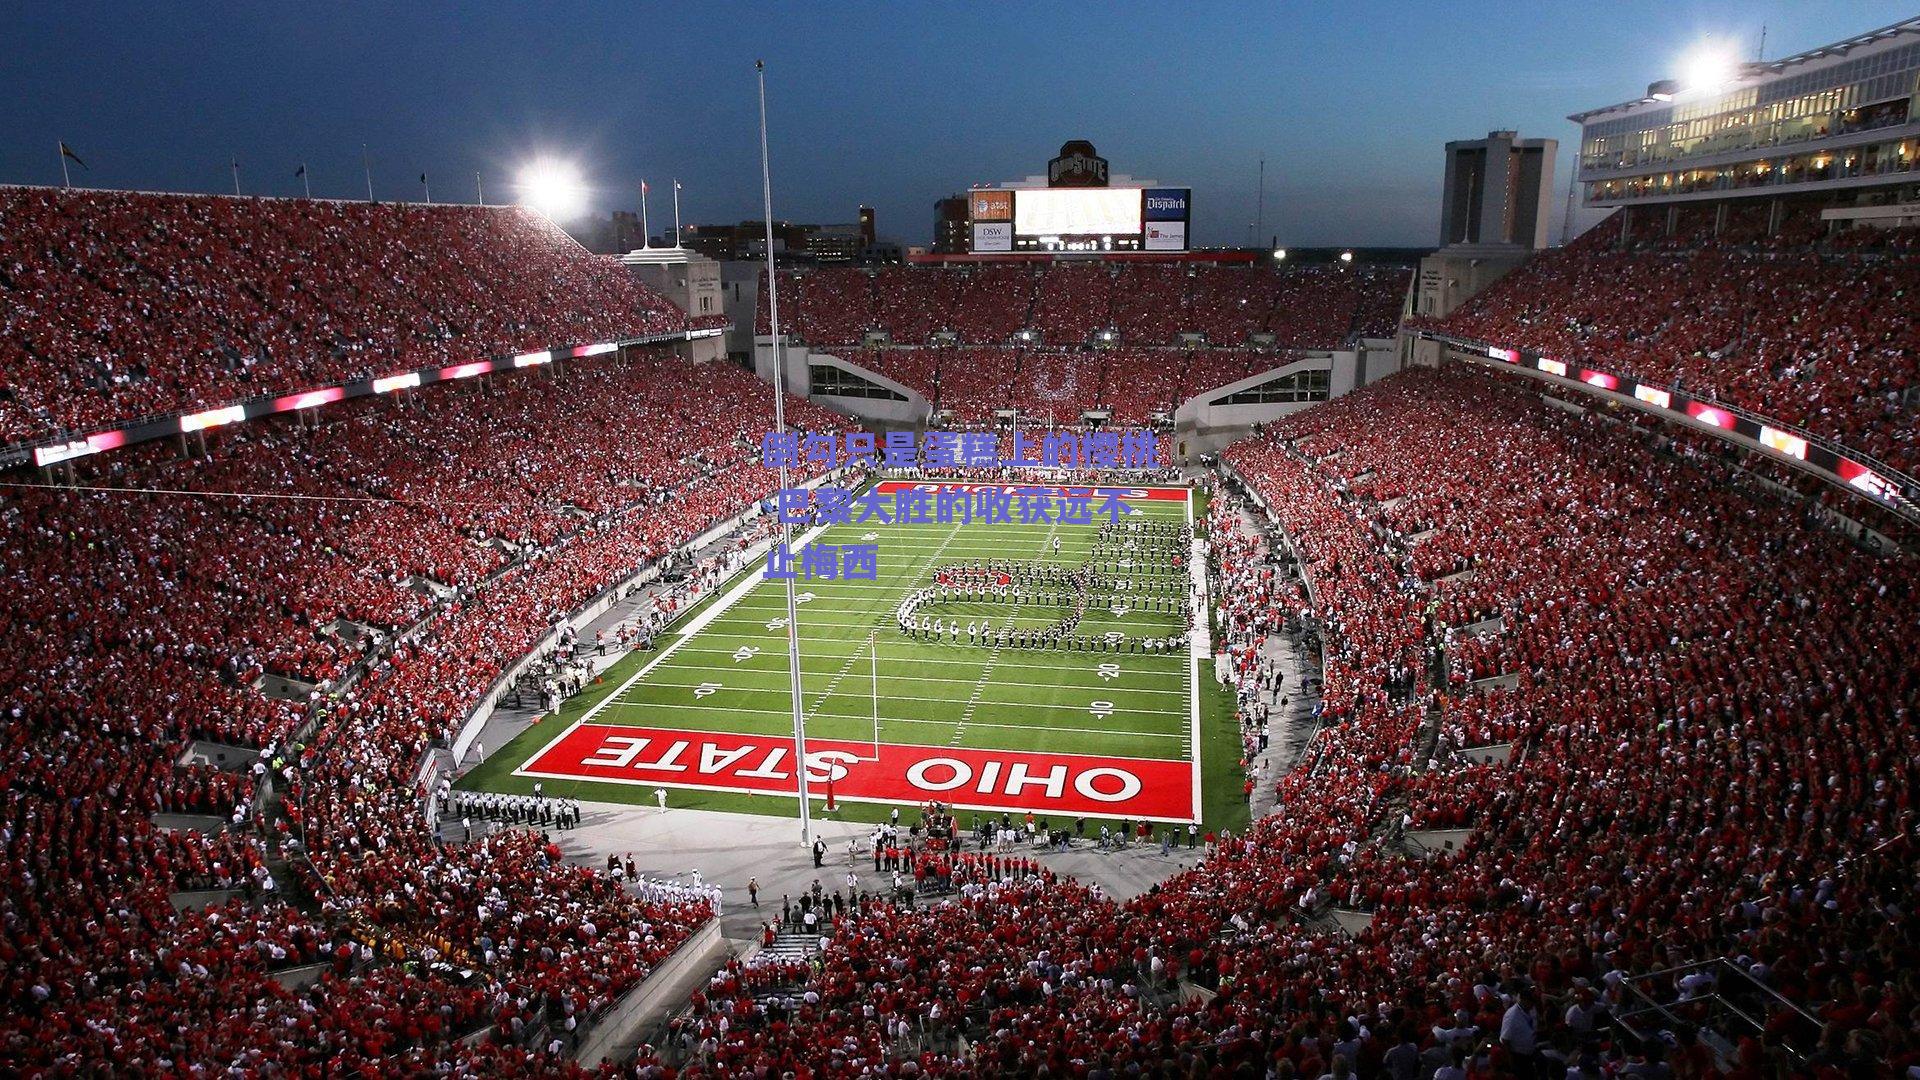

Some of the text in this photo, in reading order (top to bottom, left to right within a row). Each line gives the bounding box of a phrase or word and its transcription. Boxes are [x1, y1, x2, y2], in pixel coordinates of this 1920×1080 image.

[1072, 153, 1105, 181] STATE
[1147, 197, 1185, 211] Dispatch
[733, 646, 760, 659] 20
[1097, 663, 1120, 678] 20
[694, 682, 723, 695] 10
[1089, 701, 1114, 715] 10
[581, 736, 1142, 802] OHIO STATE
